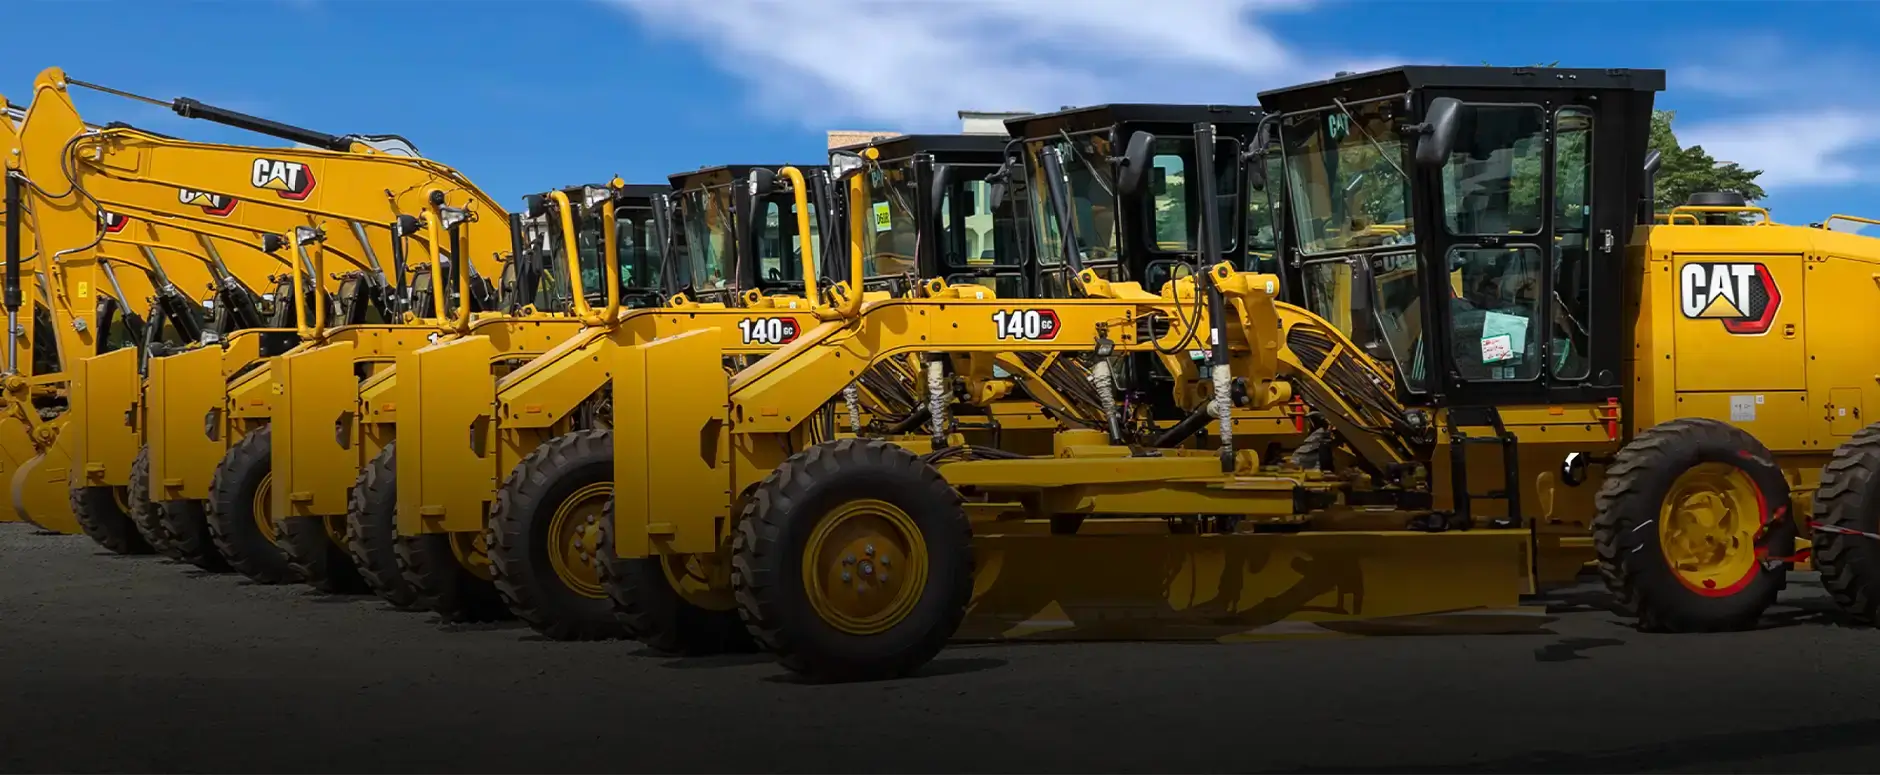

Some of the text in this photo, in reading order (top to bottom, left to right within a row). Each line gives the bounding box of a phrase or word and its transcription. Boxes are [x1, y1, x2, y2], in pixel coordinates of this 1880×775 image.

[1328, 113, 1350, 138] CAT
[252, 158, 302, 191] CAT
[1681, 263, 1755, 317] CAT
[739, 318, 793, 343] 140 GC
[993, 310, 1053, 338] 140 GC
